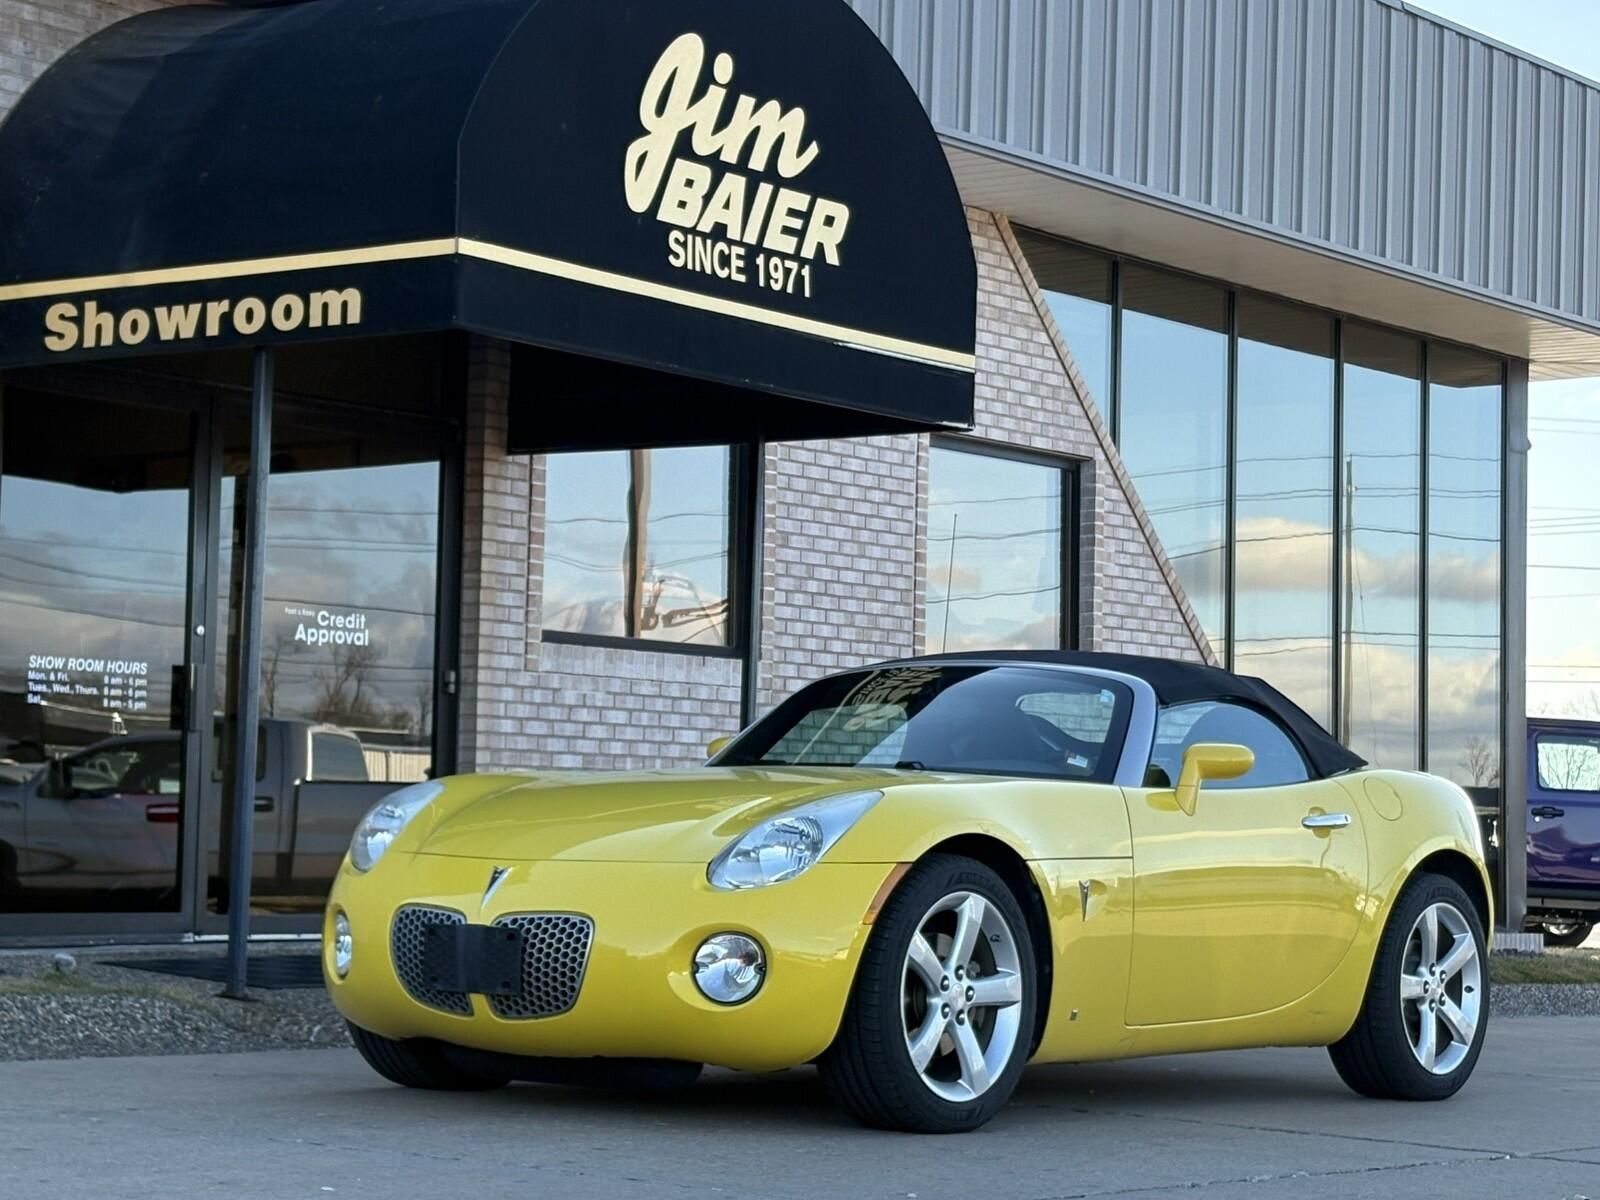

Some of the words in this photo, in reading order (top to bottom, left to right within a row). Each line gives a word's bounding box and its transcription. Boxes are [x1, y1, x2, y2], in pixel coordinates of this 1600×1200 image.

[623, 32, 820, 214] Jim
[655, 157, 850, 267] BAIER
[667, 229, 747, 283] SINCE
[755, 252, 812, 299] 1971
[44, 287, 362, 352] Showroom
[294, 623, 369, 646] Approval
[317, 611, 366, 629] Credit
[27, 669, 47, 681] Mon.
[29, 655, 65, 669] SHOW
[67, 658, 104, 672] ROOM
[106, 660, 148, 675] HOURS
